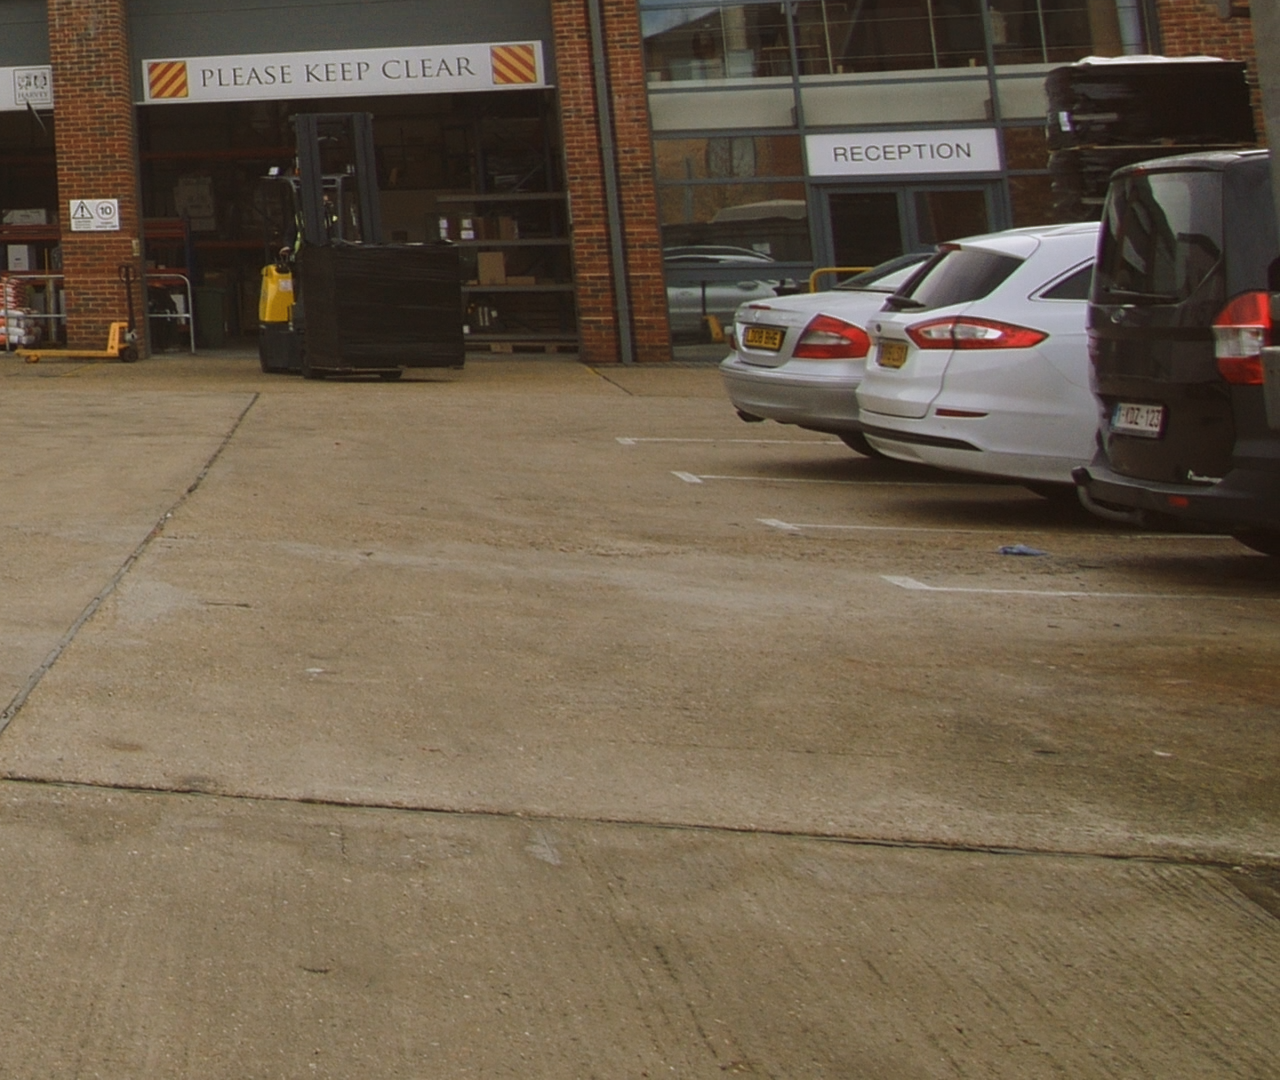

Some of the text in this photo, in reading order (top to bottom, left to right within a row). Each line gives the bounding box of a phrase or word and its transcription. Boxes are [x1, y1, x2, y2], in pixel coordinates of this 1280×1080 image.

[201, 56, 477, 88] PLEASE KEEP CLEAR
[833, 142, 972, 162] RECEPTION
[99, 206, 113, 215] 10
